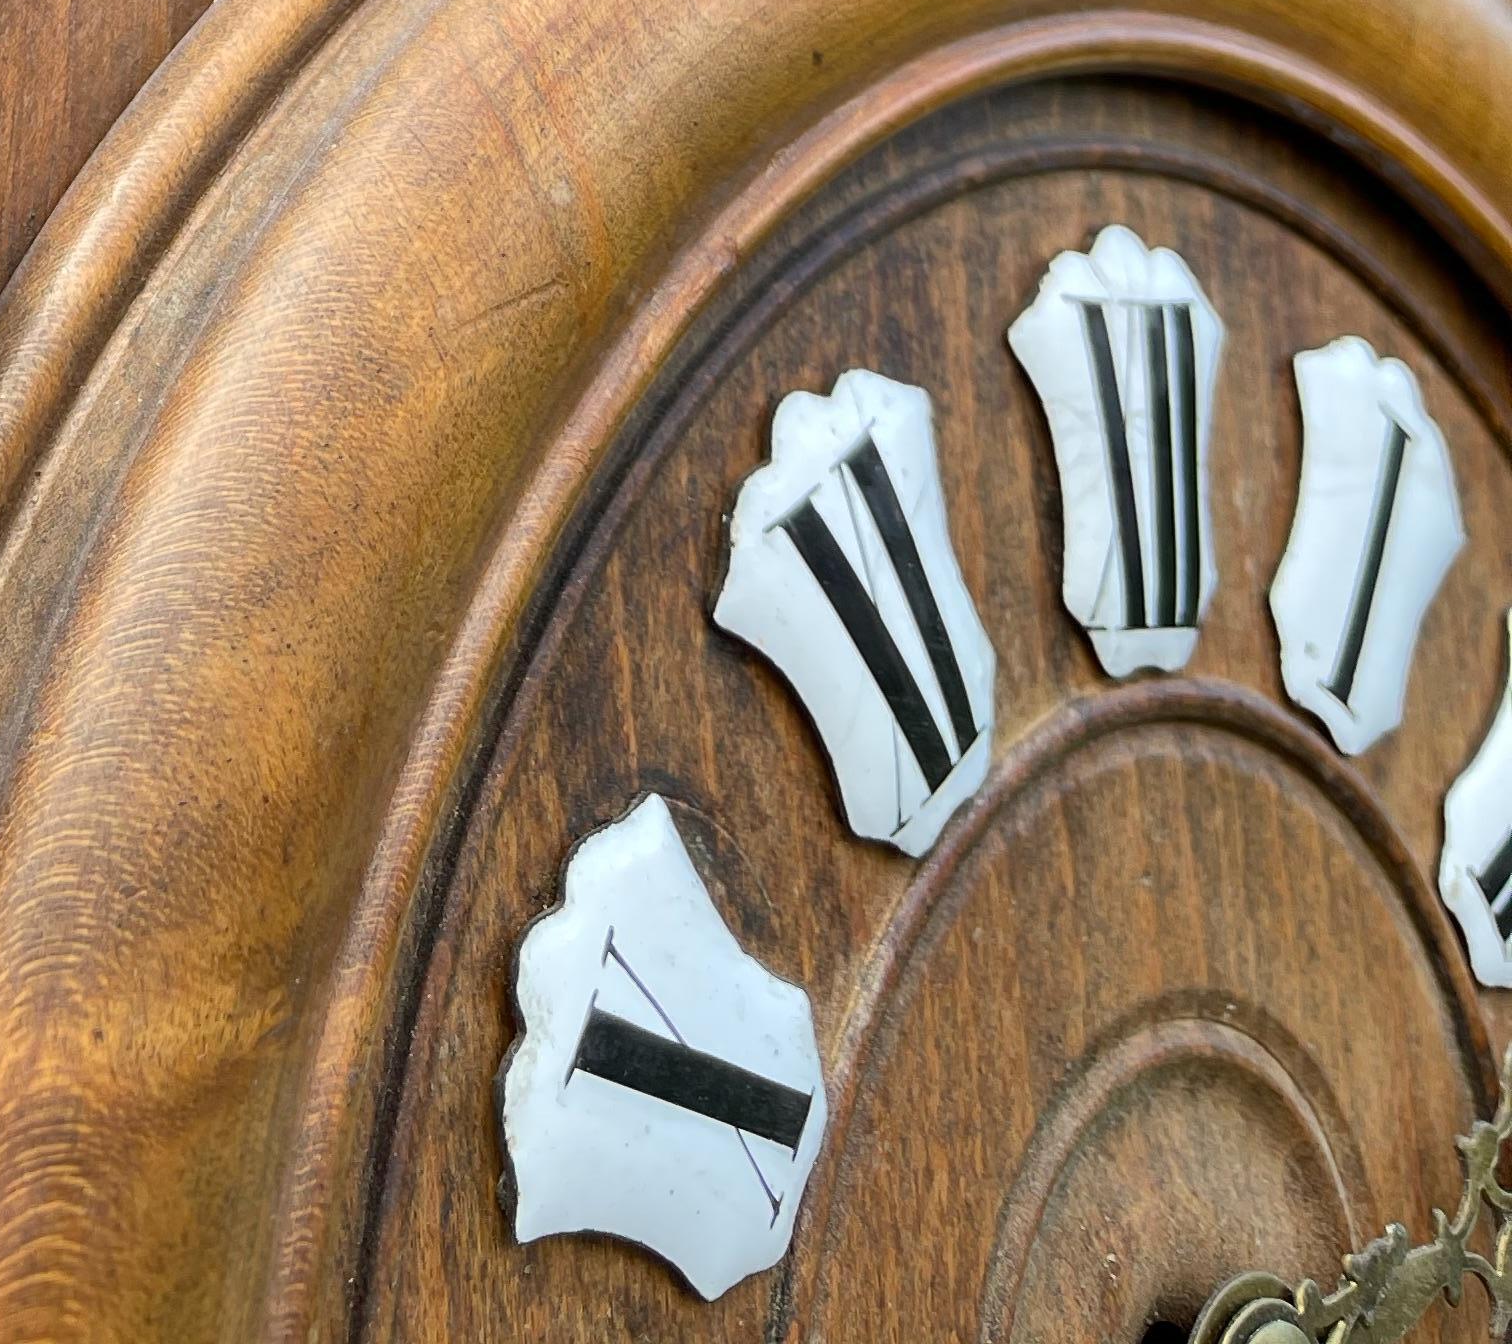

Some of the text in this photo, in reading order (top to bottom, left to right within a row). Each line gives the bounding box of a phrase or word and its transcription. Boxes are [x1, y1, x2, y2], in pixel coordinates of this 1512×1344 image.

[763, 416, 987, 837] XI
[1060, 293, 1199, 631] XII
[1318, 399, 1414, 722] I
[562, 924, 815, 1231] X
